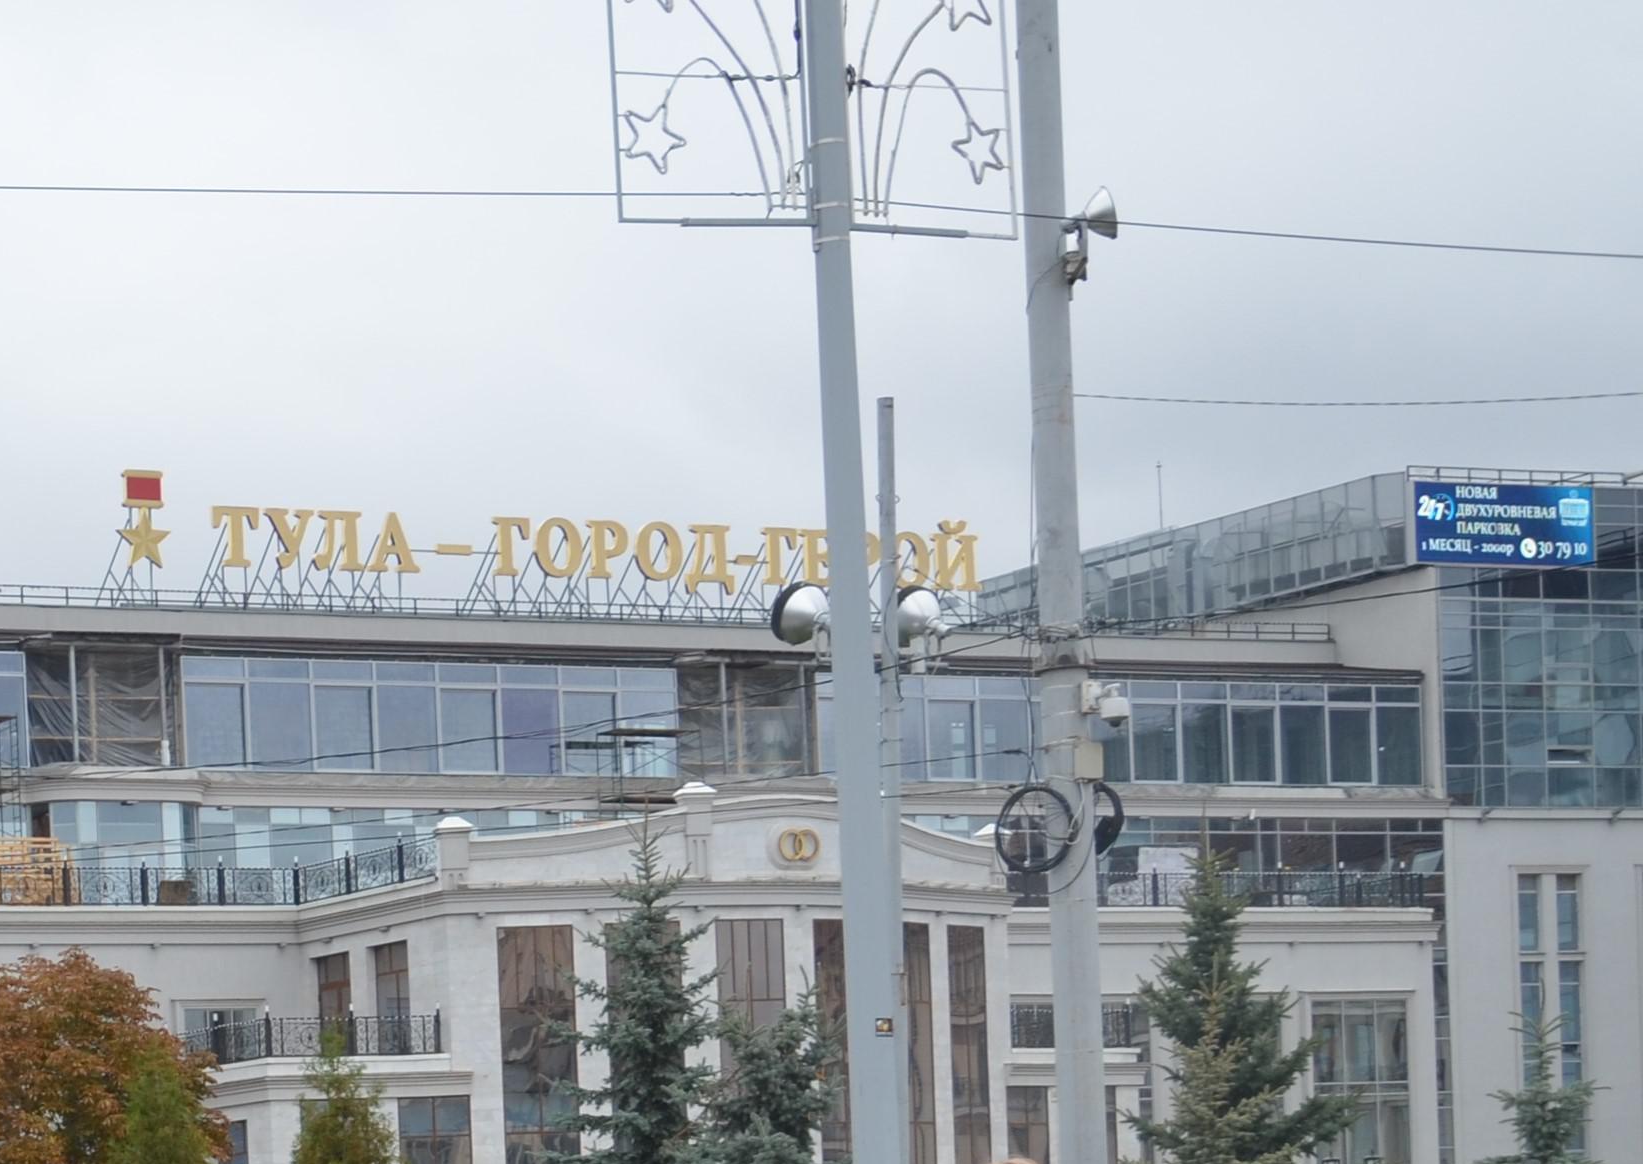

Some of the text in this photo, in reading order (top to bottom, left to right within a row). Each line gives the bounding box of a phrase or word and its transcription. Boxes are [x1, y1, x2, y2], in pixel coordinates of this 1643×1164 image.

[1456, 486, 1498, 500] НОВАЯ
[1455, 503, 1557, 519] ДВУХУРОВНЕВАЯ
[1456, 521, 1522, 536] ПАРКОВКА
[211, 505, 421, 574] ТУЛА
[1428, 538, 1472, 553] МЕСЯЦ
[1537, 541, 1588, 559] 30 79 10
